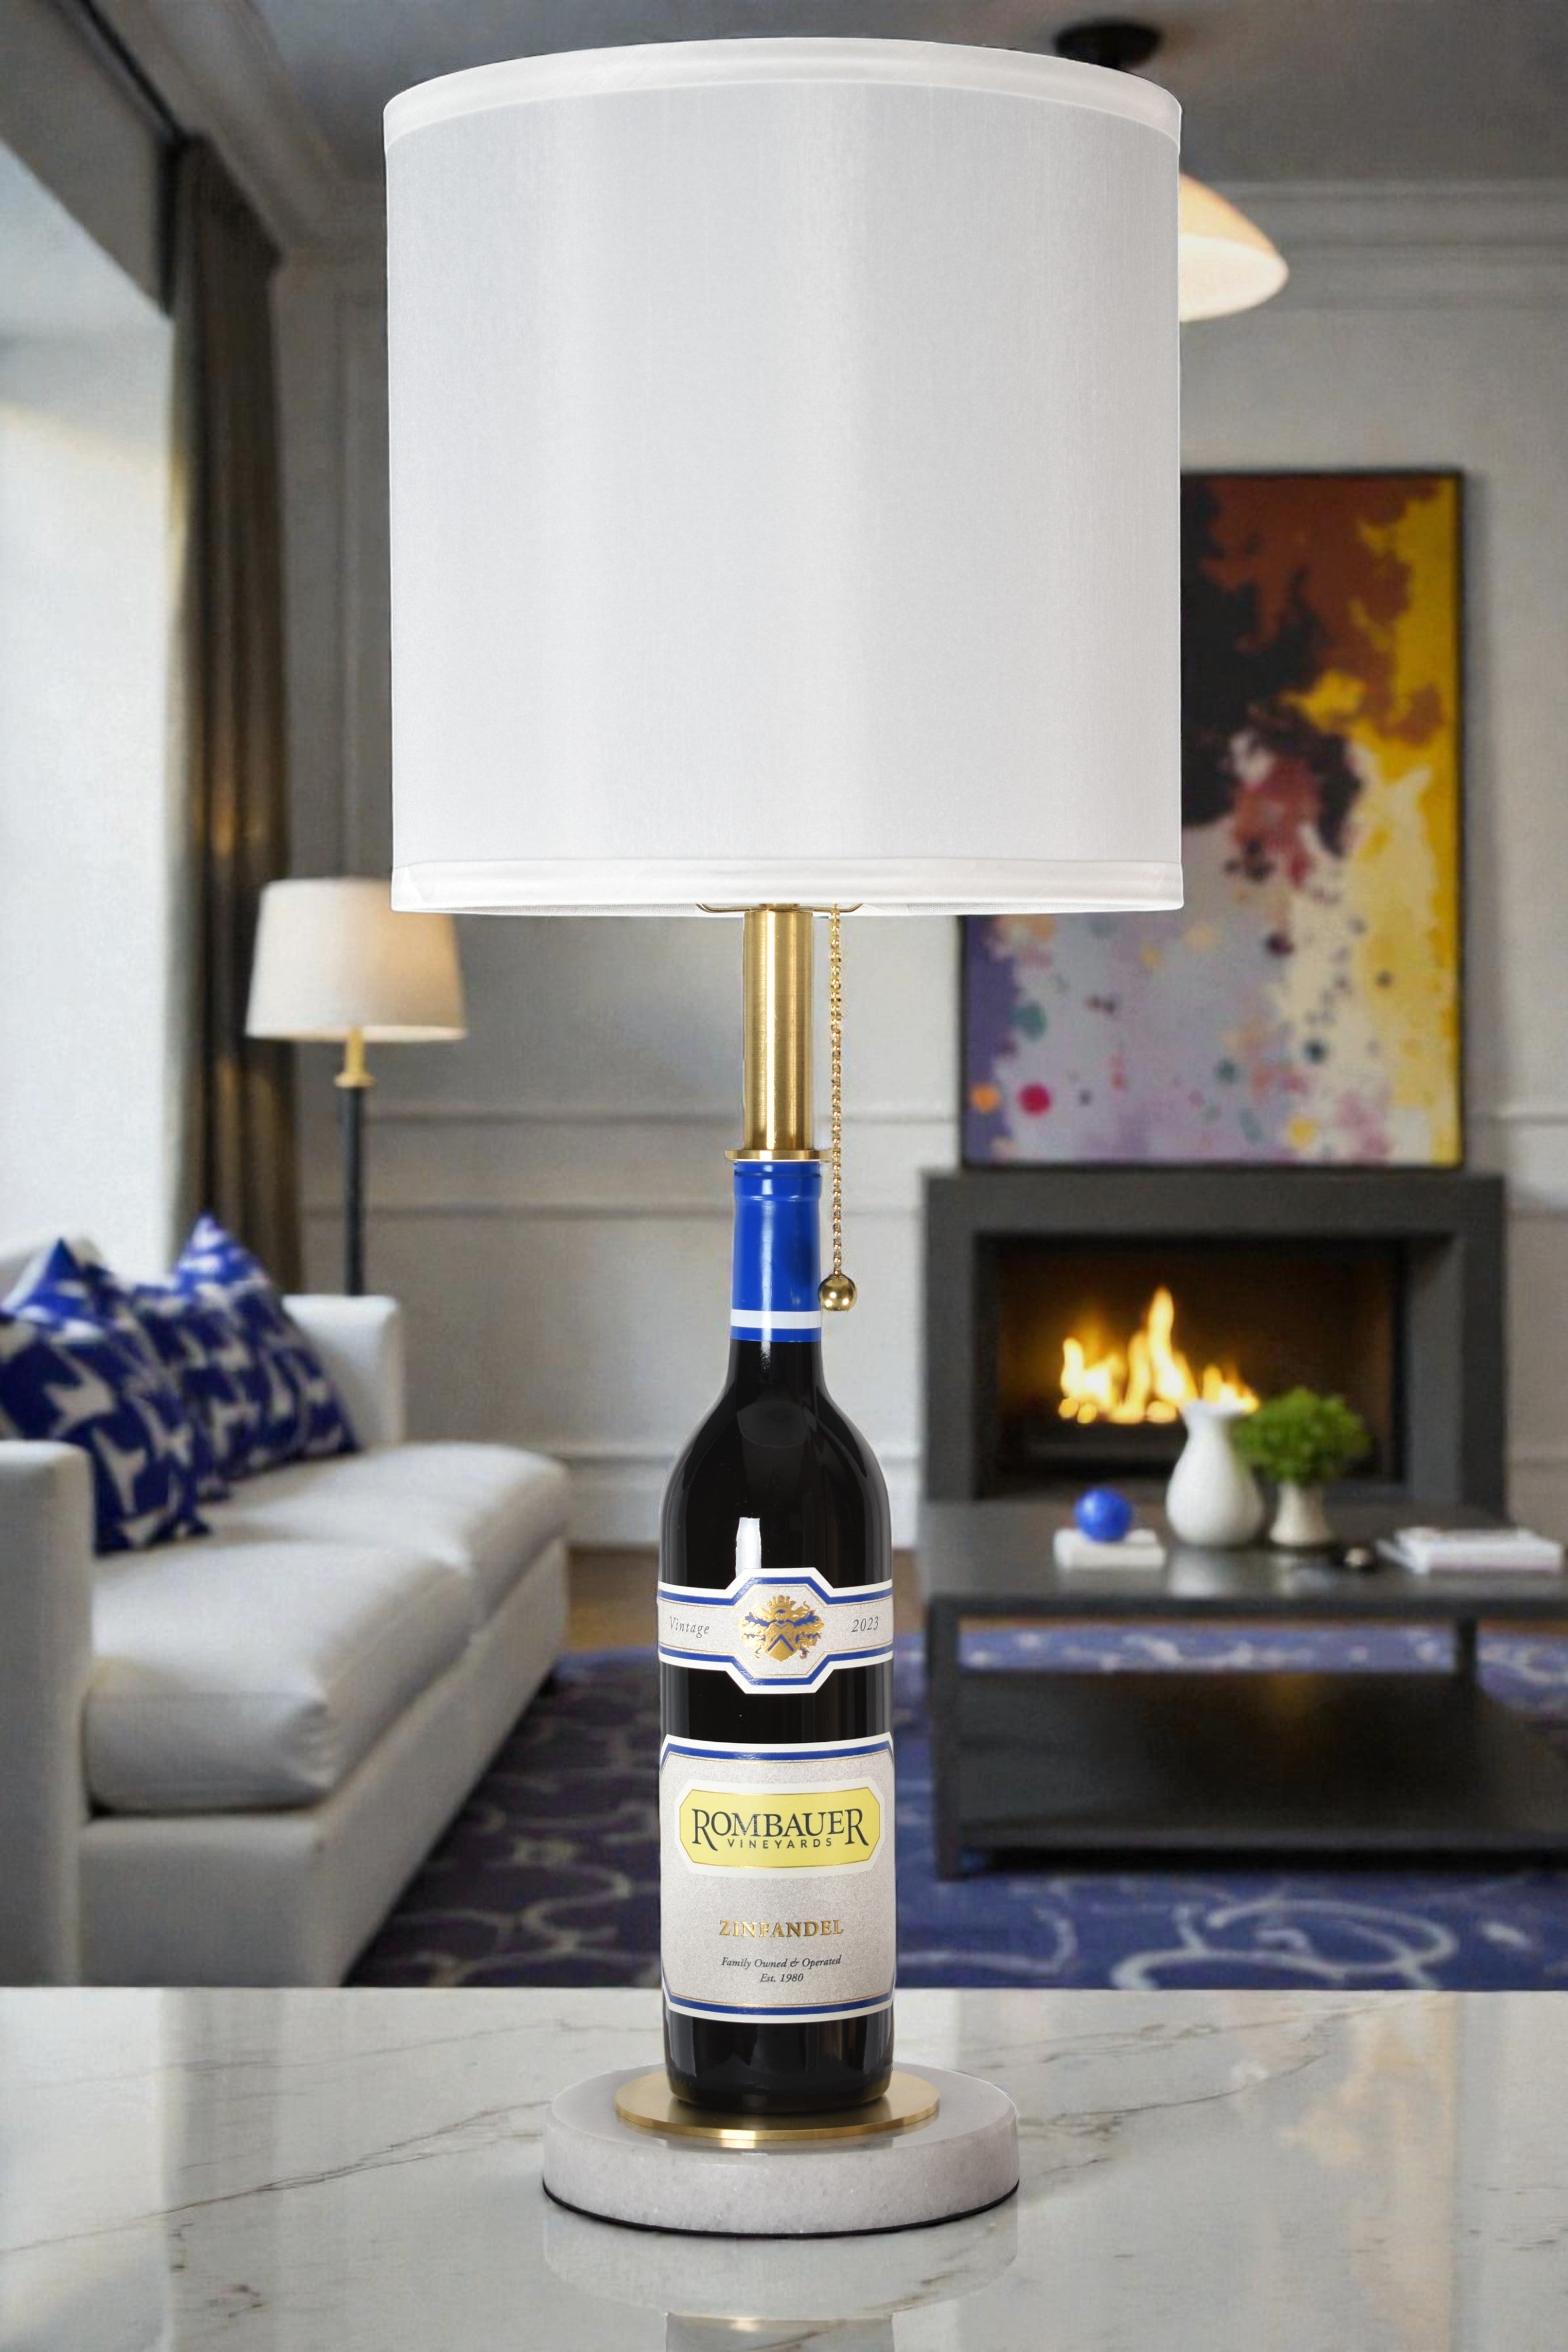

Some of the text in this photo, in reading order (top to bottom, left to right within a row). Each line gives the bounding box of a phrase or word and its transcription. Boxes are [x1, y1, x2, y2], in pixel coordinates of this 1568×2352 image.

[669, 1616, 878, 1638] Vintage 2023
[692, 1808, 869, 1851] ROMBAUER
[727, 1838, 832, 1849] VINEYARDS
[719, 1919, 844, 1937] ZINFANDEL
[721, 1955, 842, 1969] Family Owned & Operated
[760, 1973, 804, 1983] Est. 1980
